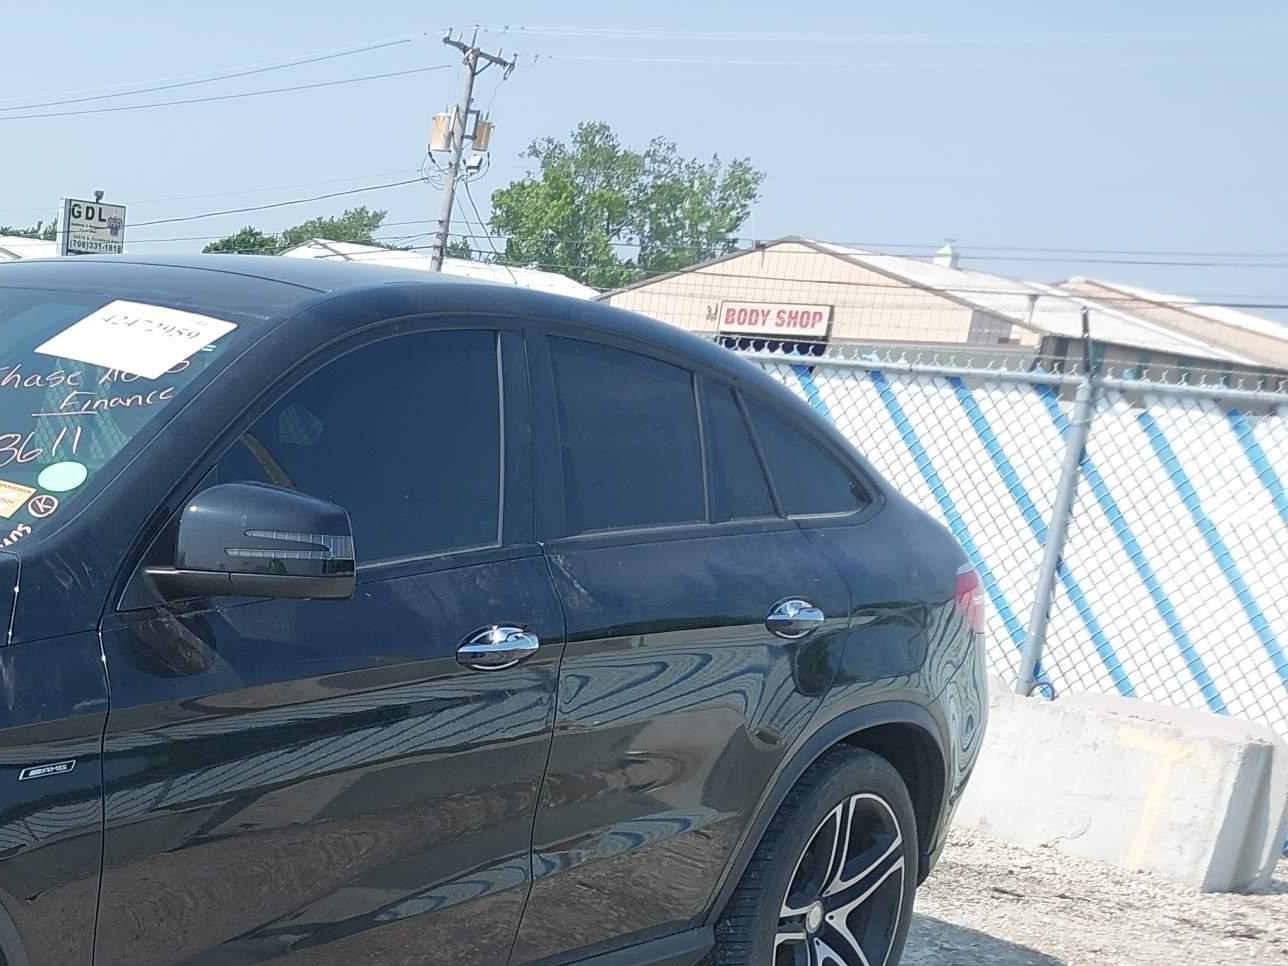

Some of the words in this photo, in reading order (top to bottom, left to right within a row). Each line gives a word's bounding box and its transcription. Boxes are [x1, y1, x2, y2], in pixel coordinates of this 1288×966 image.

[71, 204, 106, 222] GDL
[724, 307, 771, 327] BODY
[775, 309, 823, 329] SHOP
[59, 387, 175, 413] Finance
